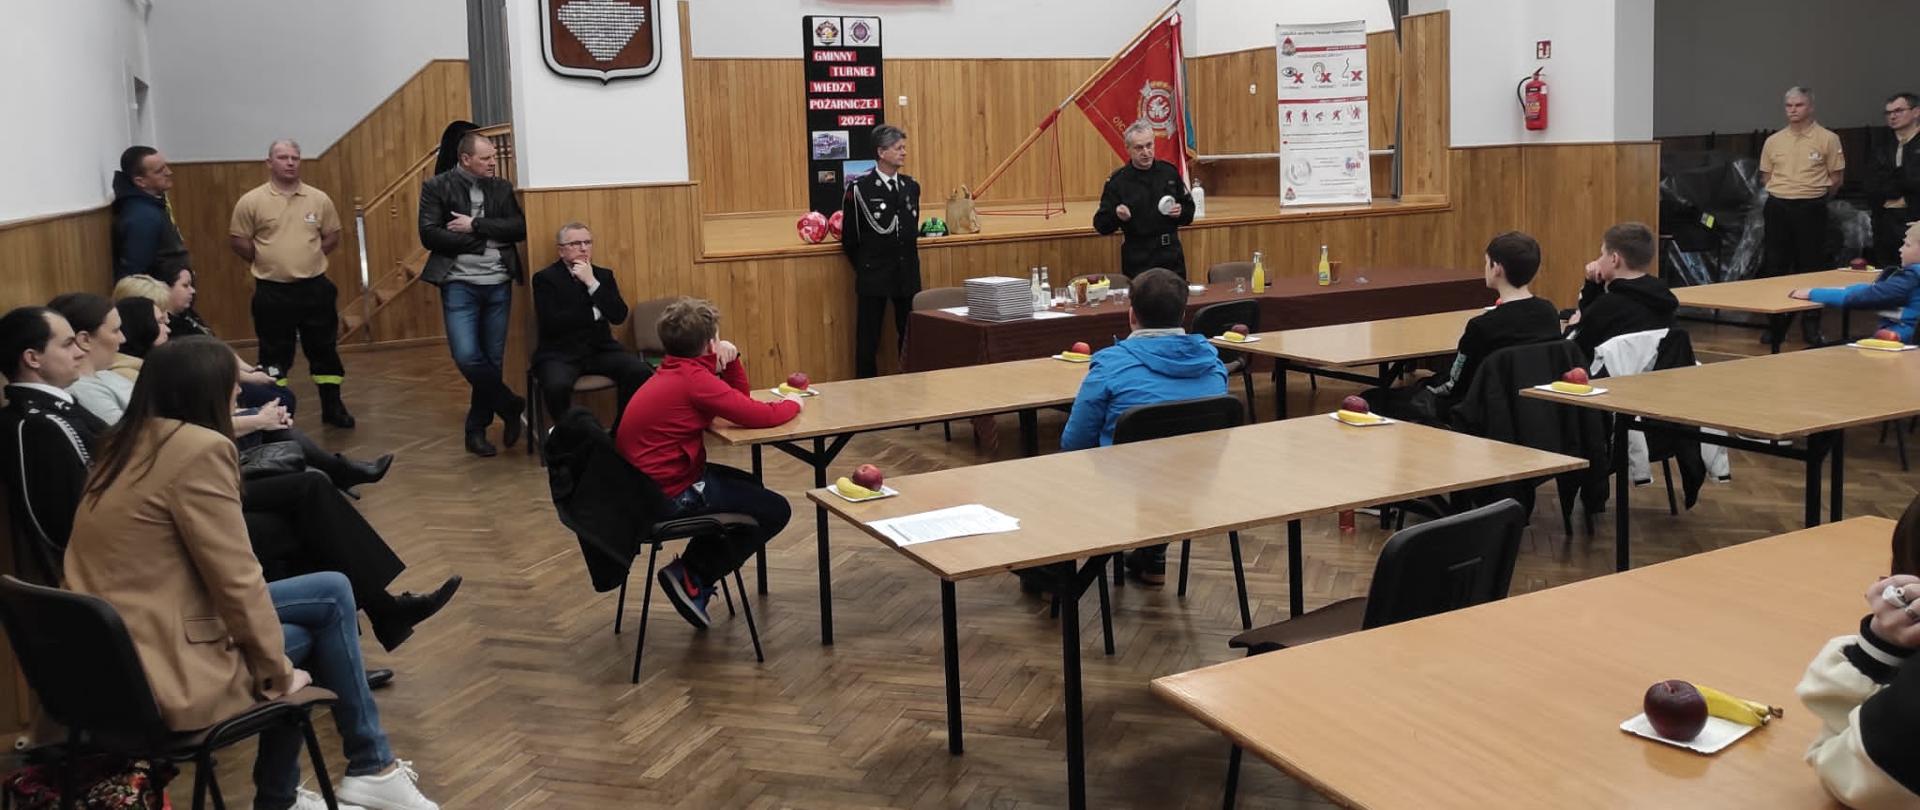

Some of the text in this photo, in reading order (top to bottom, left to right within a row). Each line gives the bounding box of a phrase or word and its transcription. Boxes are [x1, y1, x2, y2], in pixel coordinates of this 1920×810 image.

[814, 51, 853, 61] GMINNY
[833, 66, 875, 77] TURNIEJ
[814, 81, 853, 92] WIEDZY
[809, 98, 879, 110] POŻARNICZEJ
